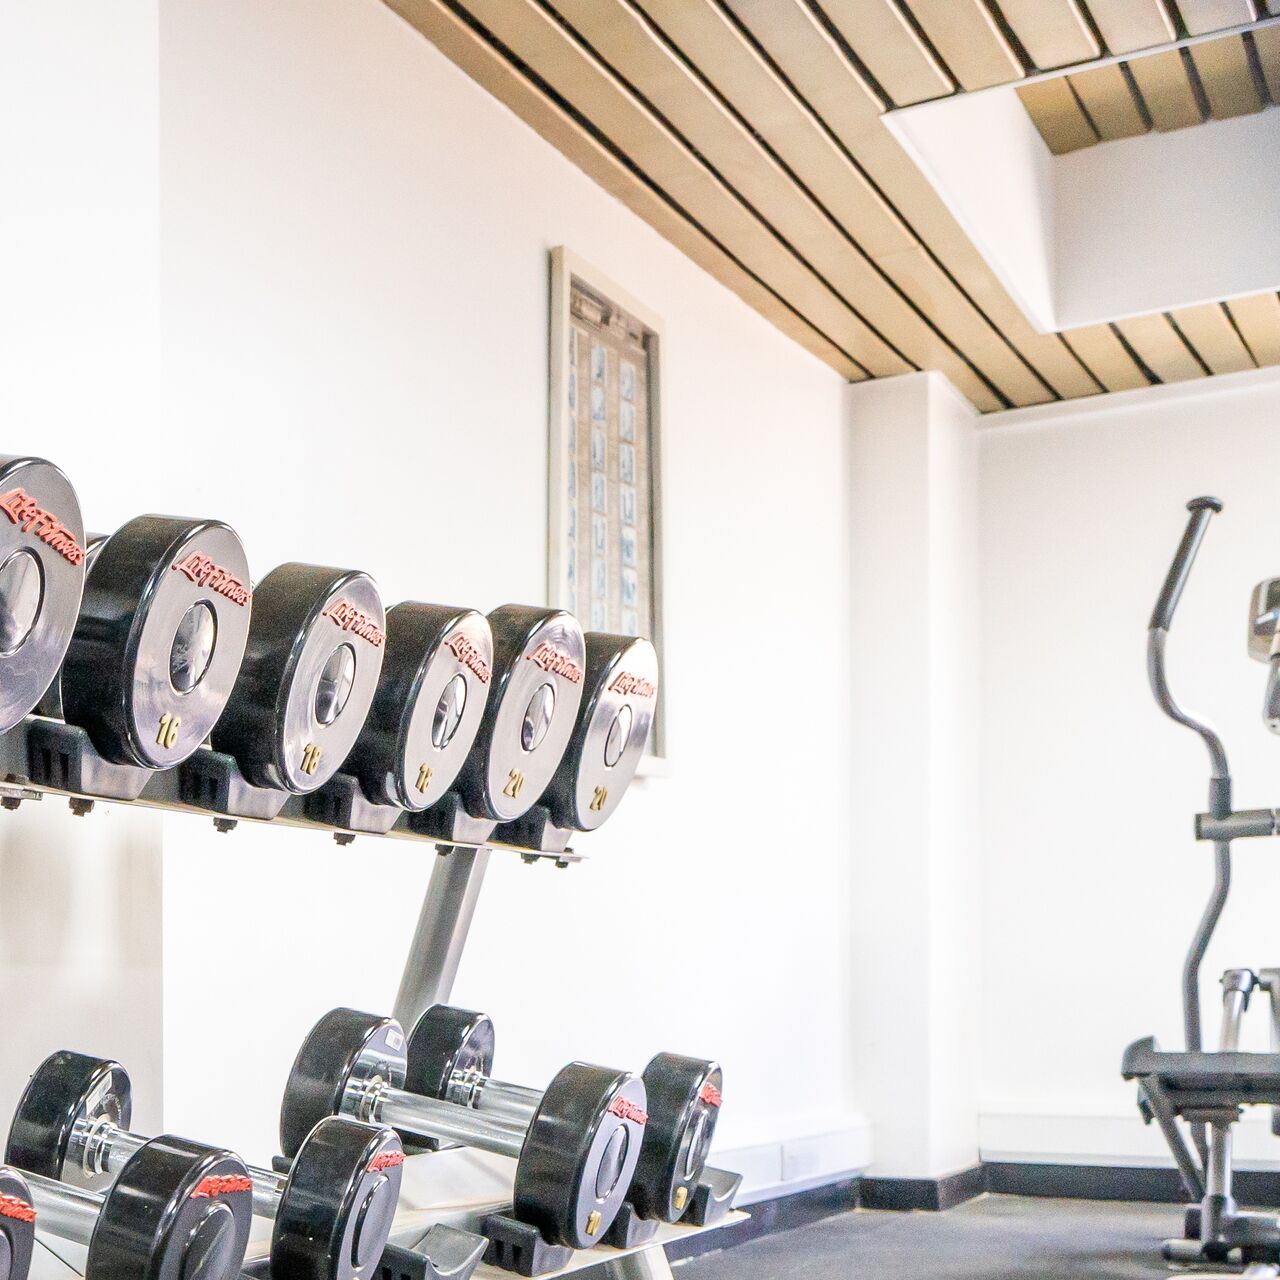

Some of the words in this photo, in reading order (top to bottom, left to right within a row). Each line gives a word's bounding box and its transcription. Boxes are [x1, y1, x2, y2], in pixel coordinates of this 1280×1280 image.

[23, 502, 85, 566] Fitness
[154, 711, 182, 750] 16
[299, 742, 323, 776] 18
